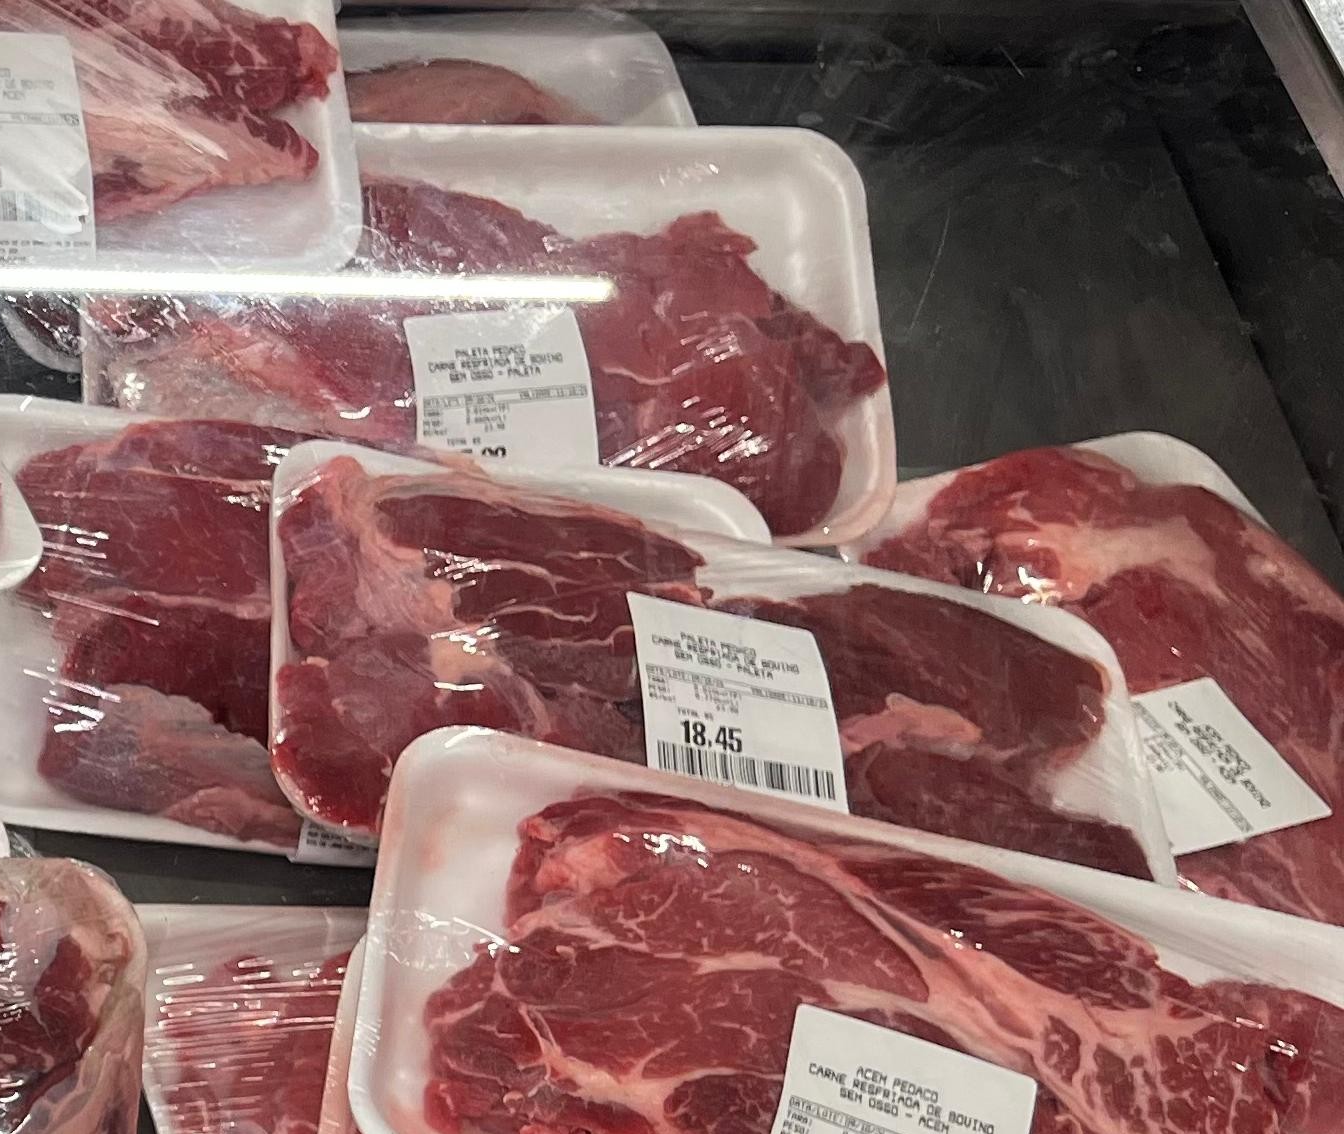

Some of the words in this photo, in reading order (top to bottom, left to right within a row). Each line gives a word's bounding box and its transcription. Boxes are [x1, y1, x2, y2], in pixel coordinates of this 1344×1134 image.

[680, 720, 742, 753] 18,45
[807, 1062, 847, 1085] CARNE
[851, 1077, 922, 1110] RESFRIADA
[925, 1104, 942, 1118] DE
[855, 1065, 888, 1084] ACEM
[891, 1078, 939, 1103] PEDACO
[838, 1089, 863, 1104] SEM
[867, 1098, 899, 1117] OSSO
[917, 1115, 950, 1134] ACEM
